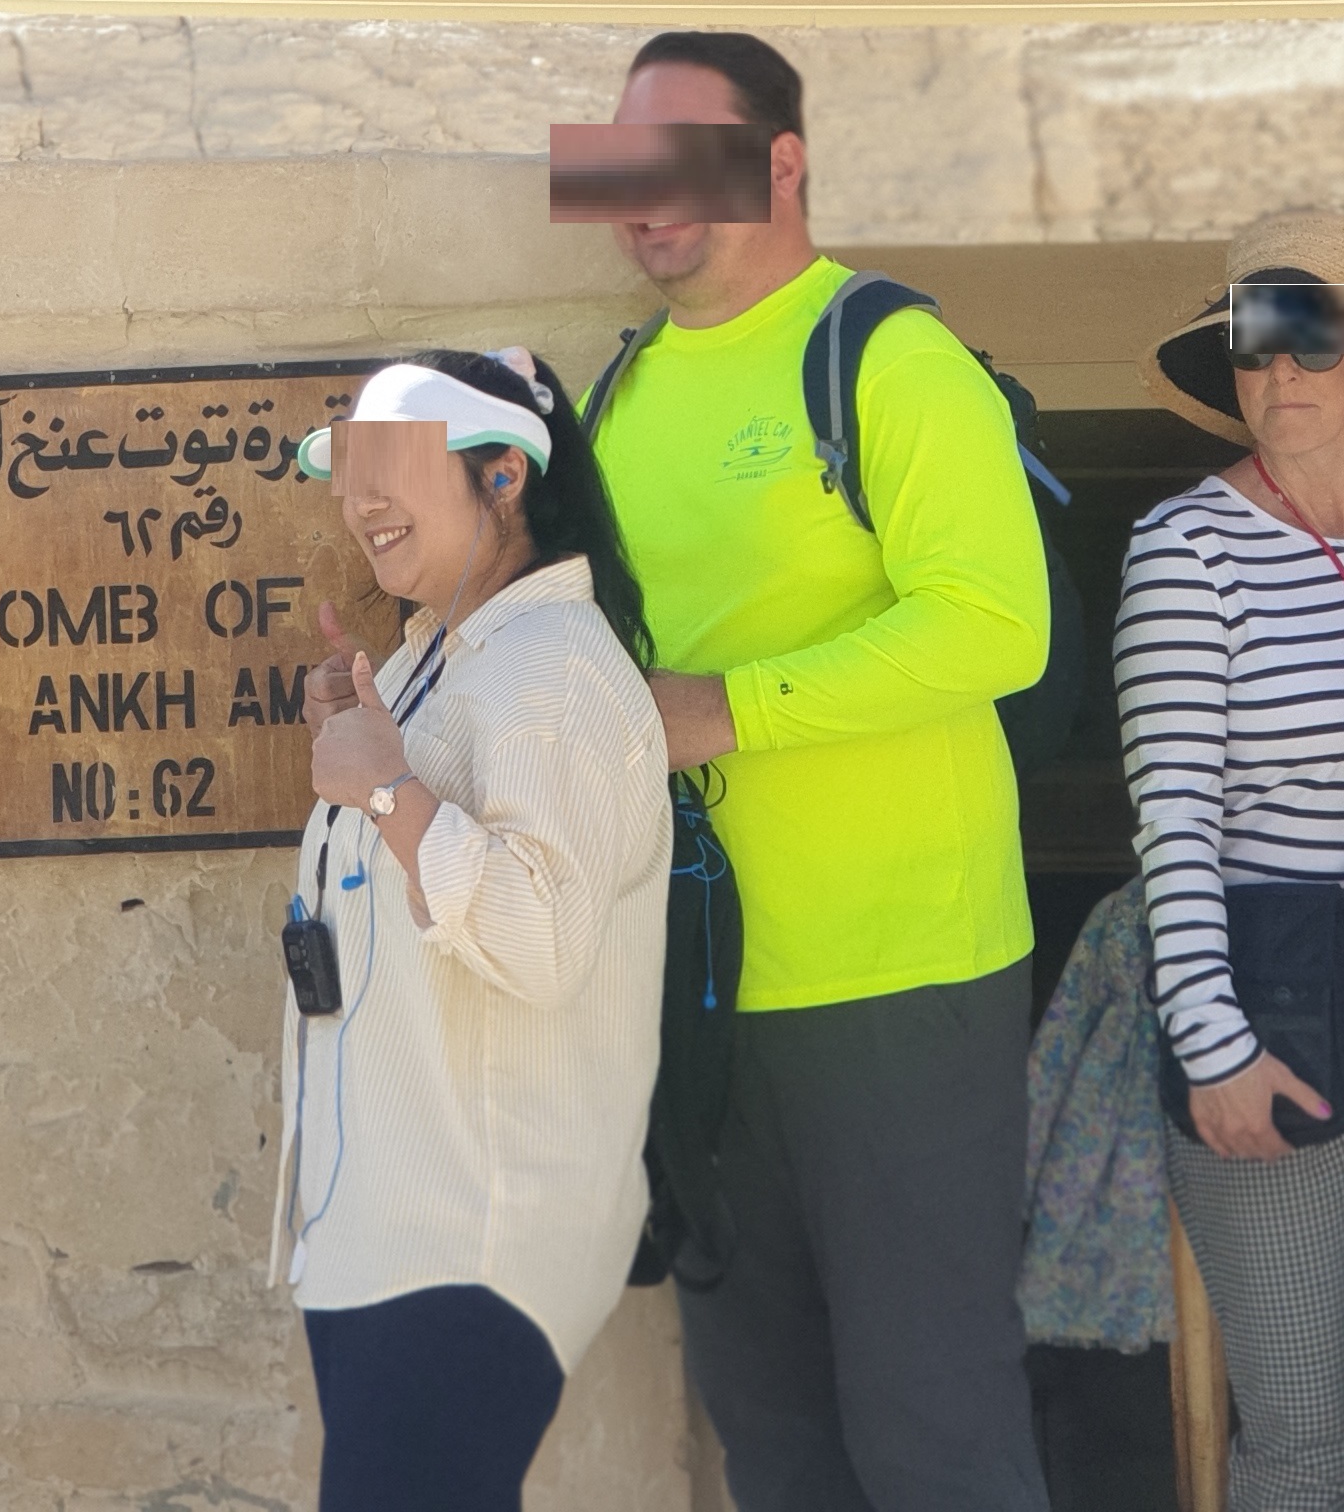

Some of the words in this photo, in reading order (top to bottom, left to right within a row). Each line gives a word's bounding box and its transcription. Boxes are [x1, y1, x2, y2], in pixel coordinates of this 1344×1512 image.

[8, 410, 115, 499] عنخ
[118, 404, 238, 486] توت
[103, 508, 162, 558] ٦٢
[170, 485, 243, 562] رقم
[205, 576, 305, 639] OF
[28, 669, 197, 736] ANKH
[227, 664, 317, 728] AM
